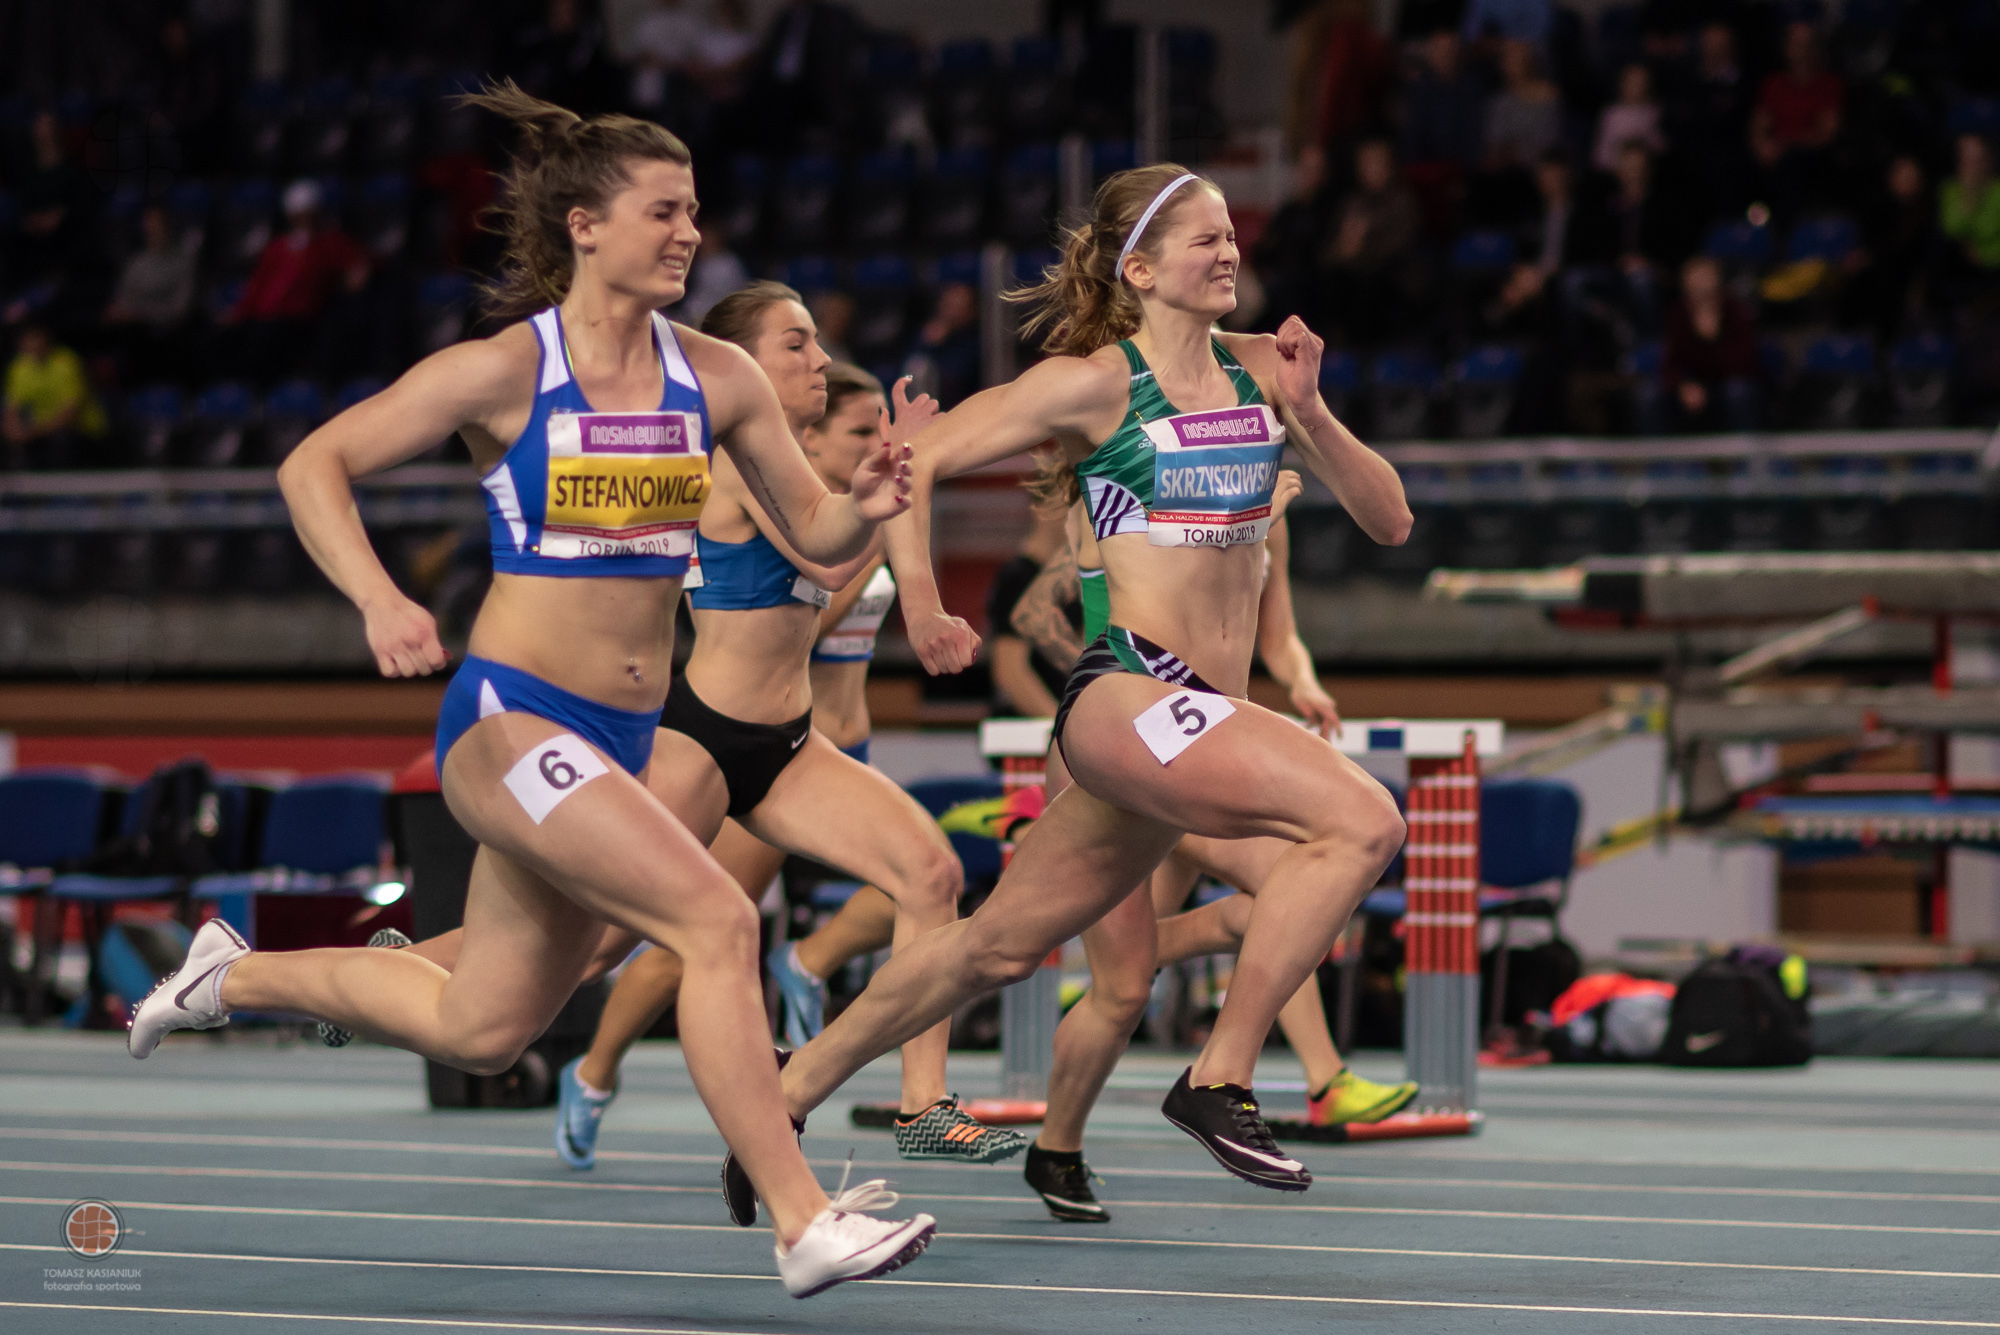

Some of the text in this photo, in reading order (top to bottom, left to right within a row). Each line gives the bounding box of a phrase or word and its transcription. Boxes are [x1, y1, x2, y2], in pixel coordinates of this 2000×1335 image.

[554, 473, 704, 508] STEFANOWICZ
[1160, 461, 1278, 498] SKRZYSZOWSKA
[640, 537, 669, 554] 2019
[1183, 525, 1256, 543] TORUŃ 2019
[1169, 695, 1207, 737] 5
